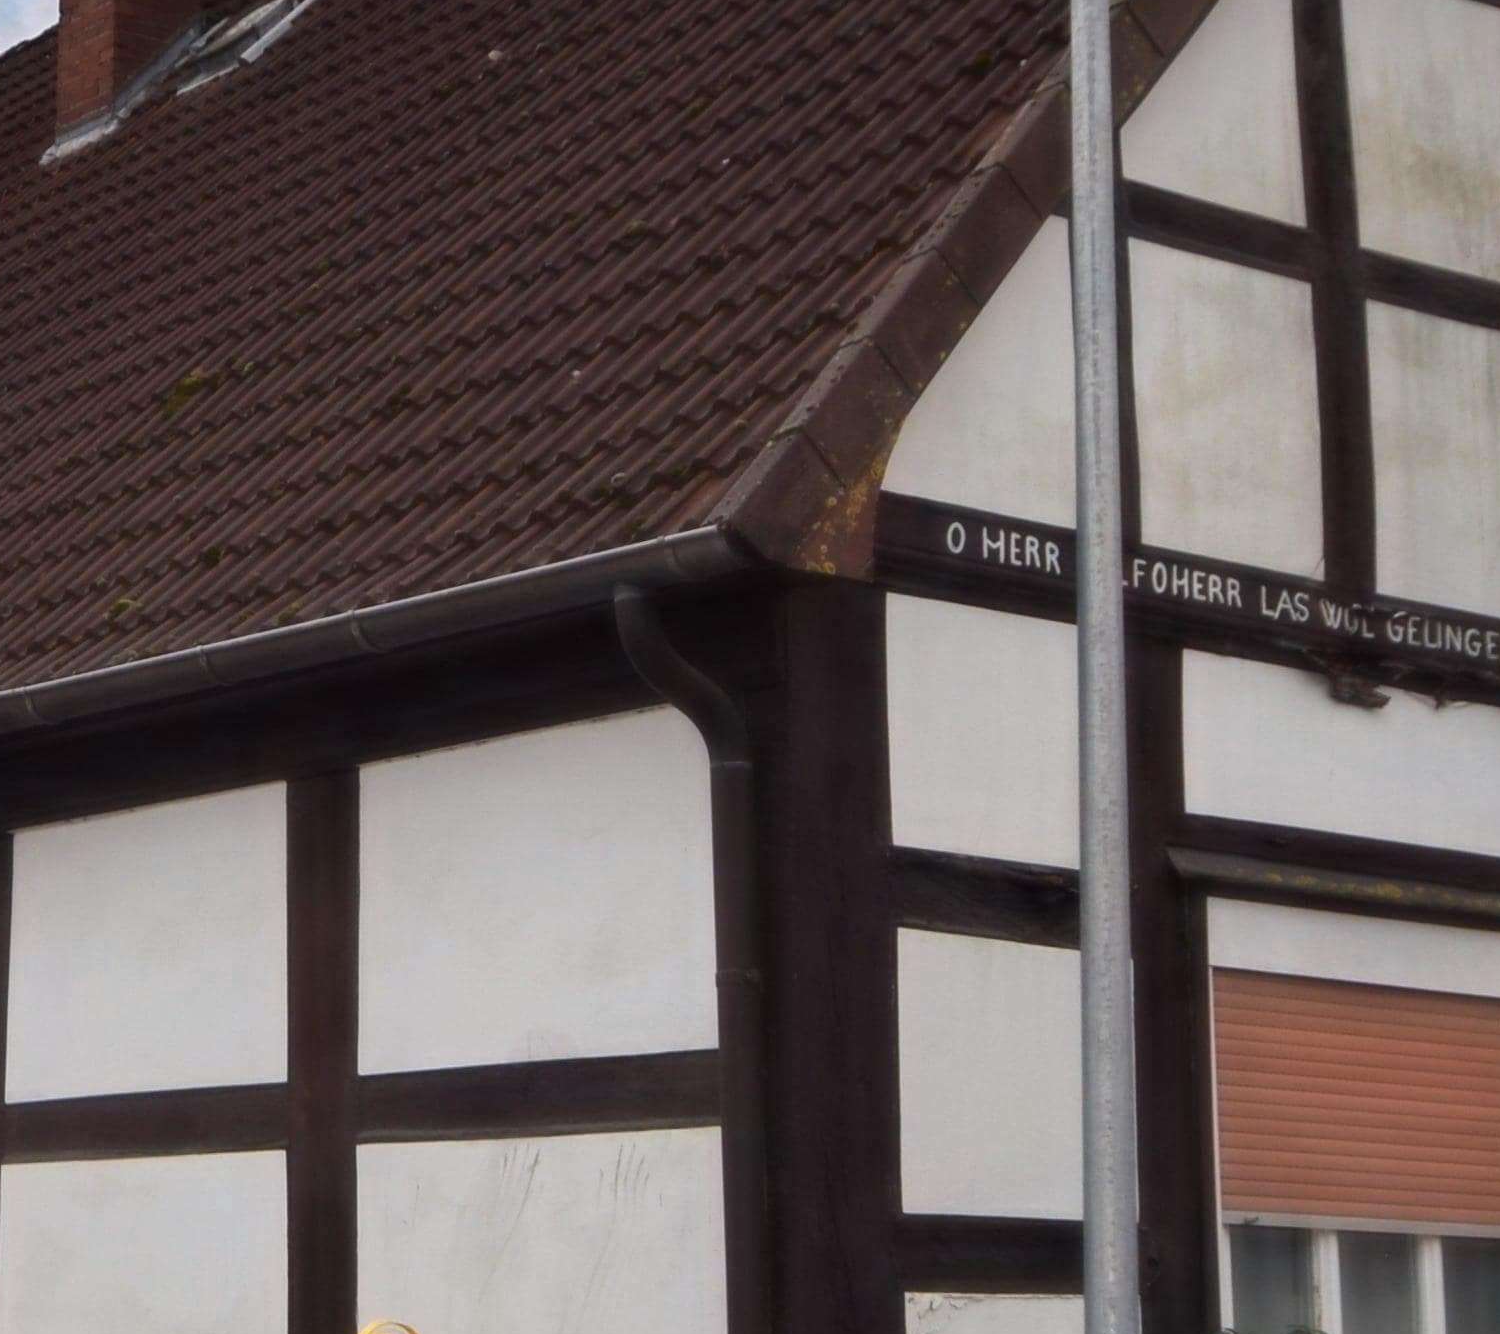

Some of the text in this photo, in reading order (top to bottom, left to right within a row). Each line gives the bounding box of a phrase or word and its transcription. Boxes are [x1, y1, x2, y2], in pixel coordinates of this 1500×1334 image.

[946, 521, 966, 554] O
[982, 525, 1062, 576] HERR
[1261, 585, 1310, 623] LAS
